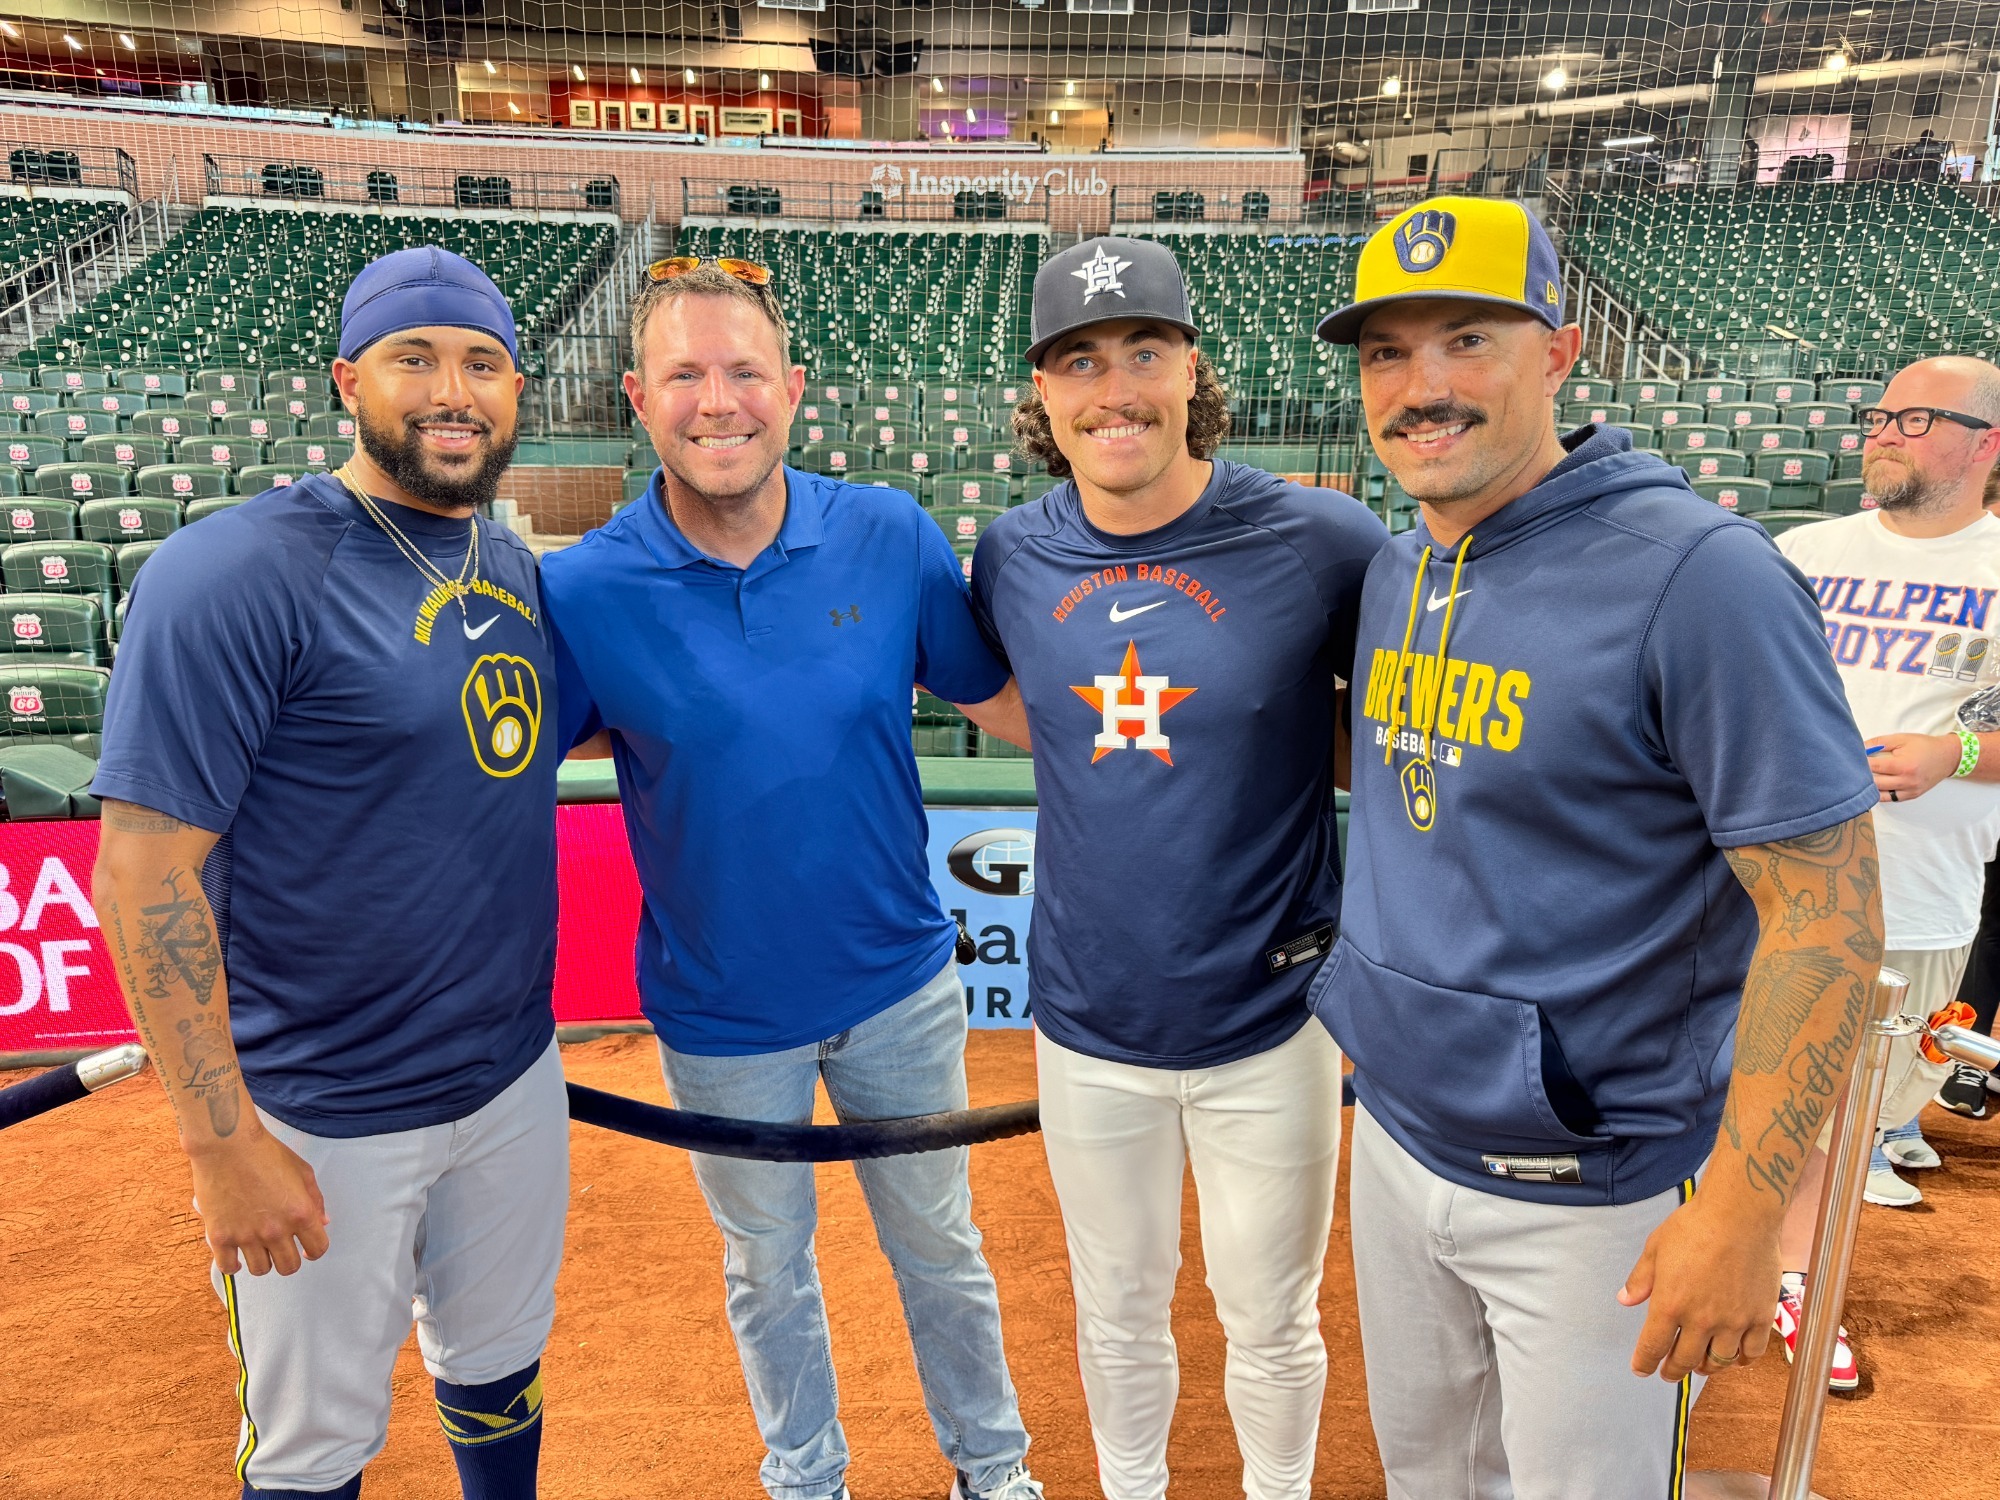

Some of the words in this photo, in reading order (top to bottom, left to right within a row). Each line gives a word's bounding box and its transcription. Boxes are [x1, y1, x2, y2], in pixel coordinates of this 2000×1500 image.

[907, 168, 1040, 204] Insperity
[1043, 167, 1108, 196] Club
[472, 579, 537, 627] BASEBALL
[1053, 565, 1128, 623] HOUSTON
[1137, 563, 1226, 623] BASEBALL
[1806, 576, 1998, 631] ULLPEN
[17, 697, 37, 710] 66
[1094, 675, 1170, 749] H
[1363, 649, 1531, 752] BREWERS
[1375, 725, 1437, 760] BASEBAL
[1788, 970, 1866, 1097] Arena
[178, 1058, 238, 1090] Lennox
[1757, 1087, 1824, 1159] the
[1746, 1152, 1796, 1206] In
